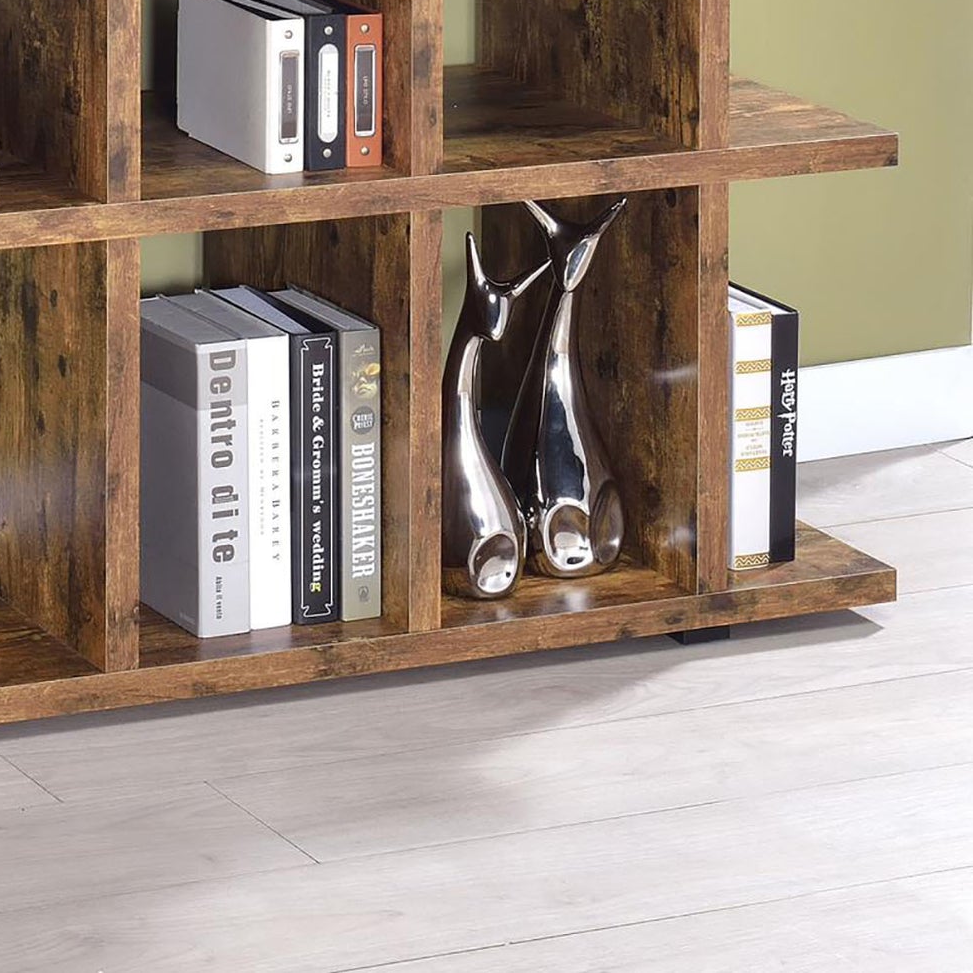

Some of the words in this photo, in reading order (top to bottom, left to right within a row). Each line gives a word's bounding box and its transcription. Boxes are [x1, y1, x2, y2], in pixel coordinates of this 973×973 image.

[209, 349, 237, 469] Dentro
[312, 363, 325, 412] Bride
[780, 368, 796, 411] Harry
[312, 416, 325, 432] &
[777, 411, 797, 457] Potter
[312, 434, 325, 514] Gromm's
[211, 484, 240, 520] di
[351, 442, 375, 579] BONESHAKER
[212, 529, 239, 564] te
[309, 520, 325, 593] wedding
